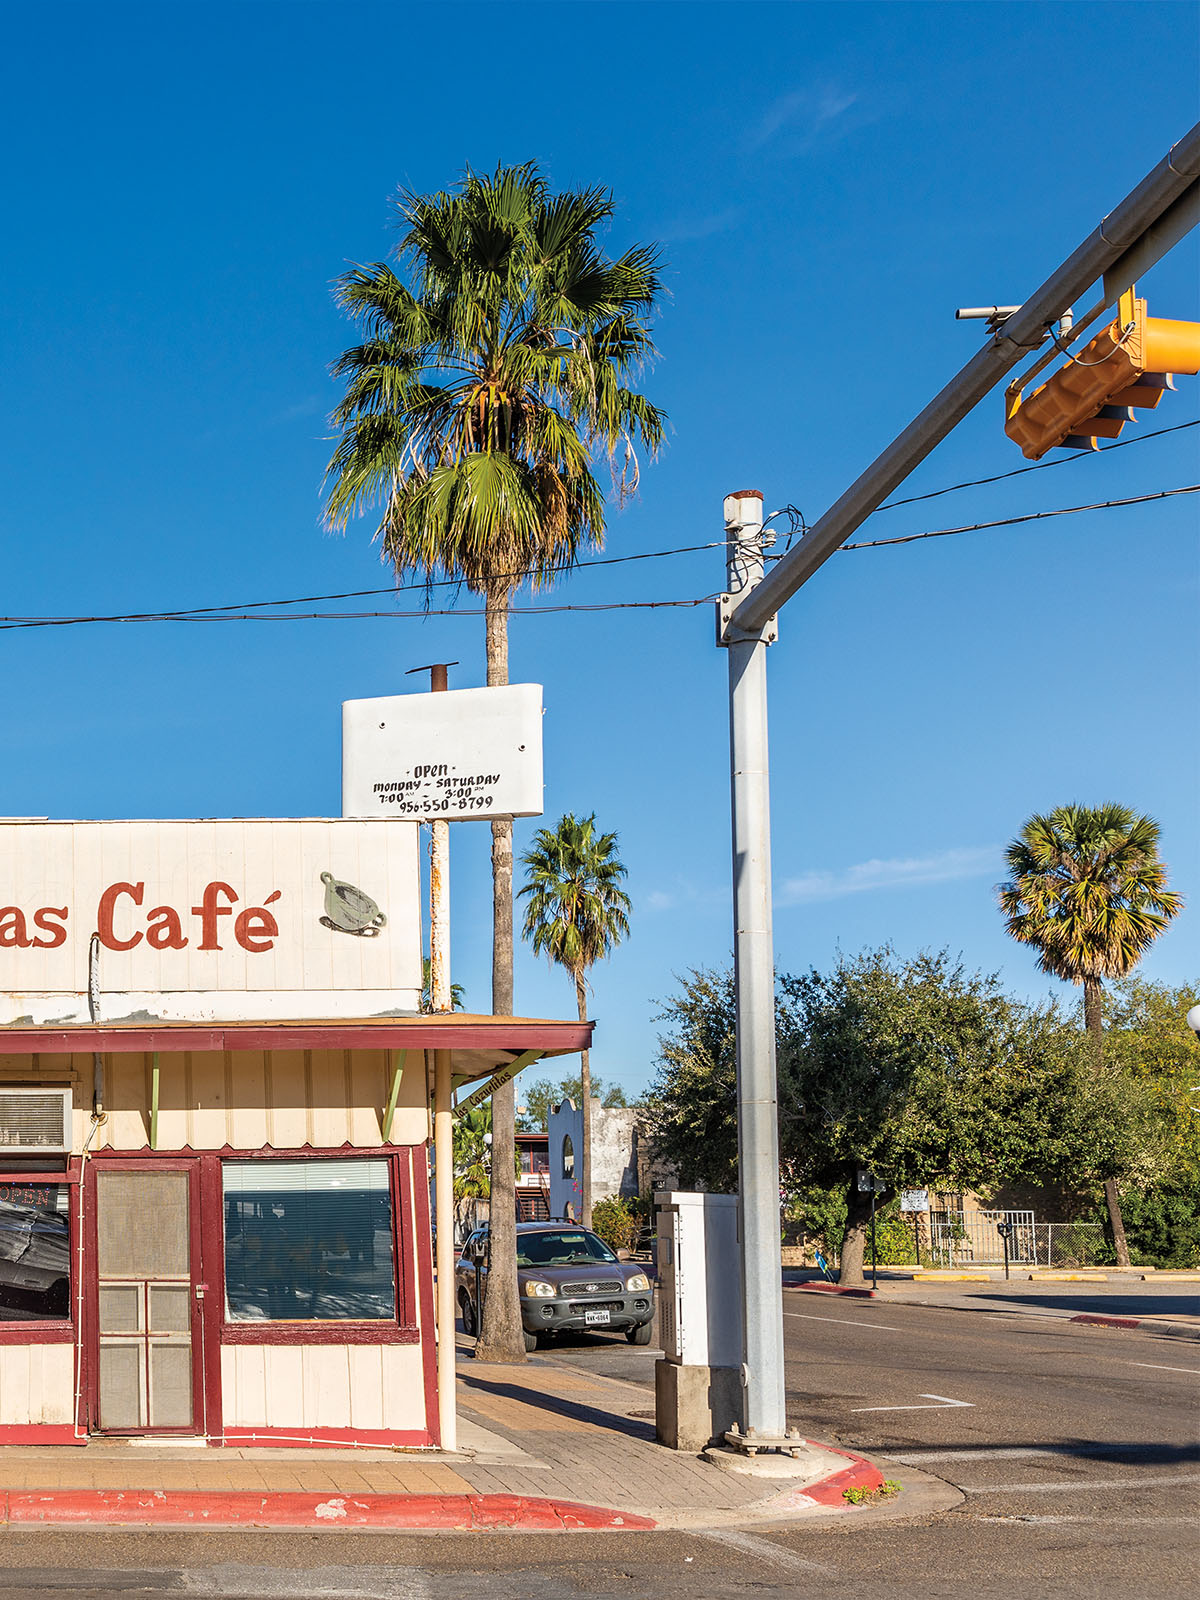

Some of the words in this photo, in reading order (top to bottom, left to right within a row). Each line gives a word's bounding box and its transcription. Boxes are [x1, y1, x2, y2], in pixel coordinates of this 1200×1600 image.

[436, 773, 501, 788] SATURDAY
[378, 792, 404, 804] 7:00
[444, 787, 472, 799] 3:00
[97, 881, 282, 953] Café
